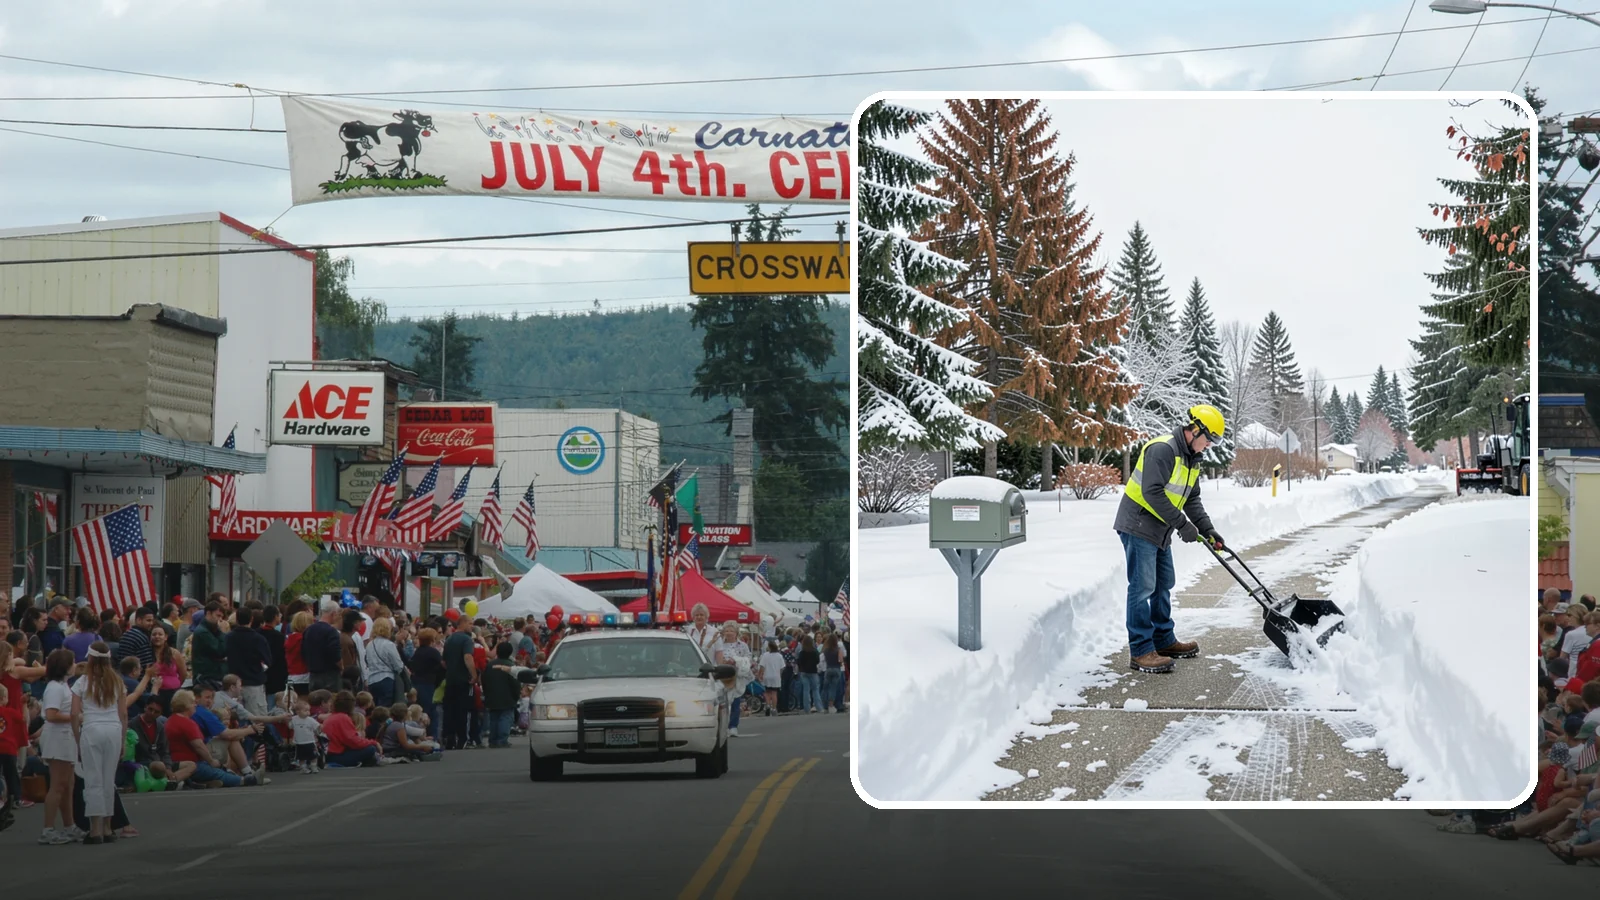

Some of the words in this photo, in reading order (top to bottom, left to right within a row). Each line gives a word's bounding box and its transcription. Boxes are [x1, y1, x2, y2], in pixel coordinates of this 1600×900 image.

[481, 141, 605, 193] JULY
[632, 149, 746, 198] 4th.
[696, 254, 850, 280] CROSSWA
[282, 379, 374, 420] ACE
[405, 408, 453, 422] CEDAR
[283, 420, 371, 437] Hardware
[353, 466, 384, 480] Simpl
[95, 485, 124, 495] Vincent
[126, 485, 135, 495] de
[137, 485, 155, 495] Paul
[688, 526, 741, 535] CRNATION
[699, 535, 730, 543] GLASS
